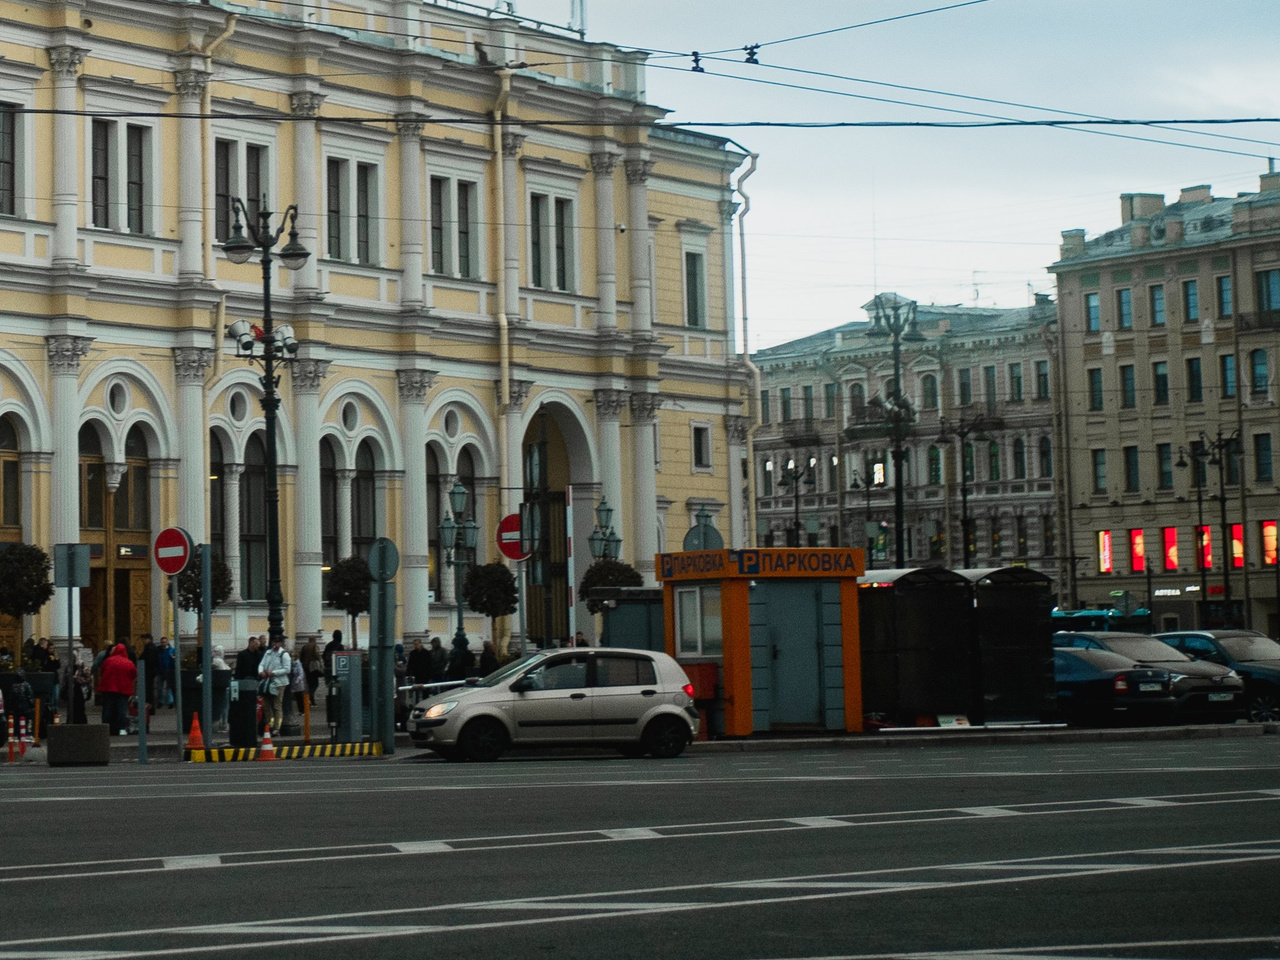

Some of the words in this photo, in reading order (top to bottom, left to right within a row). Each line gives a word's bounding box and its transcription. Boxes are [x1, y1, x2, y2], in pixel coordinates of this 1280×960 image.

[673, 554, 724, 573] ПАРКОВКА
[743, 553, 757, 572] P
[761, 553, 856, 572] ПАРКОВКА
